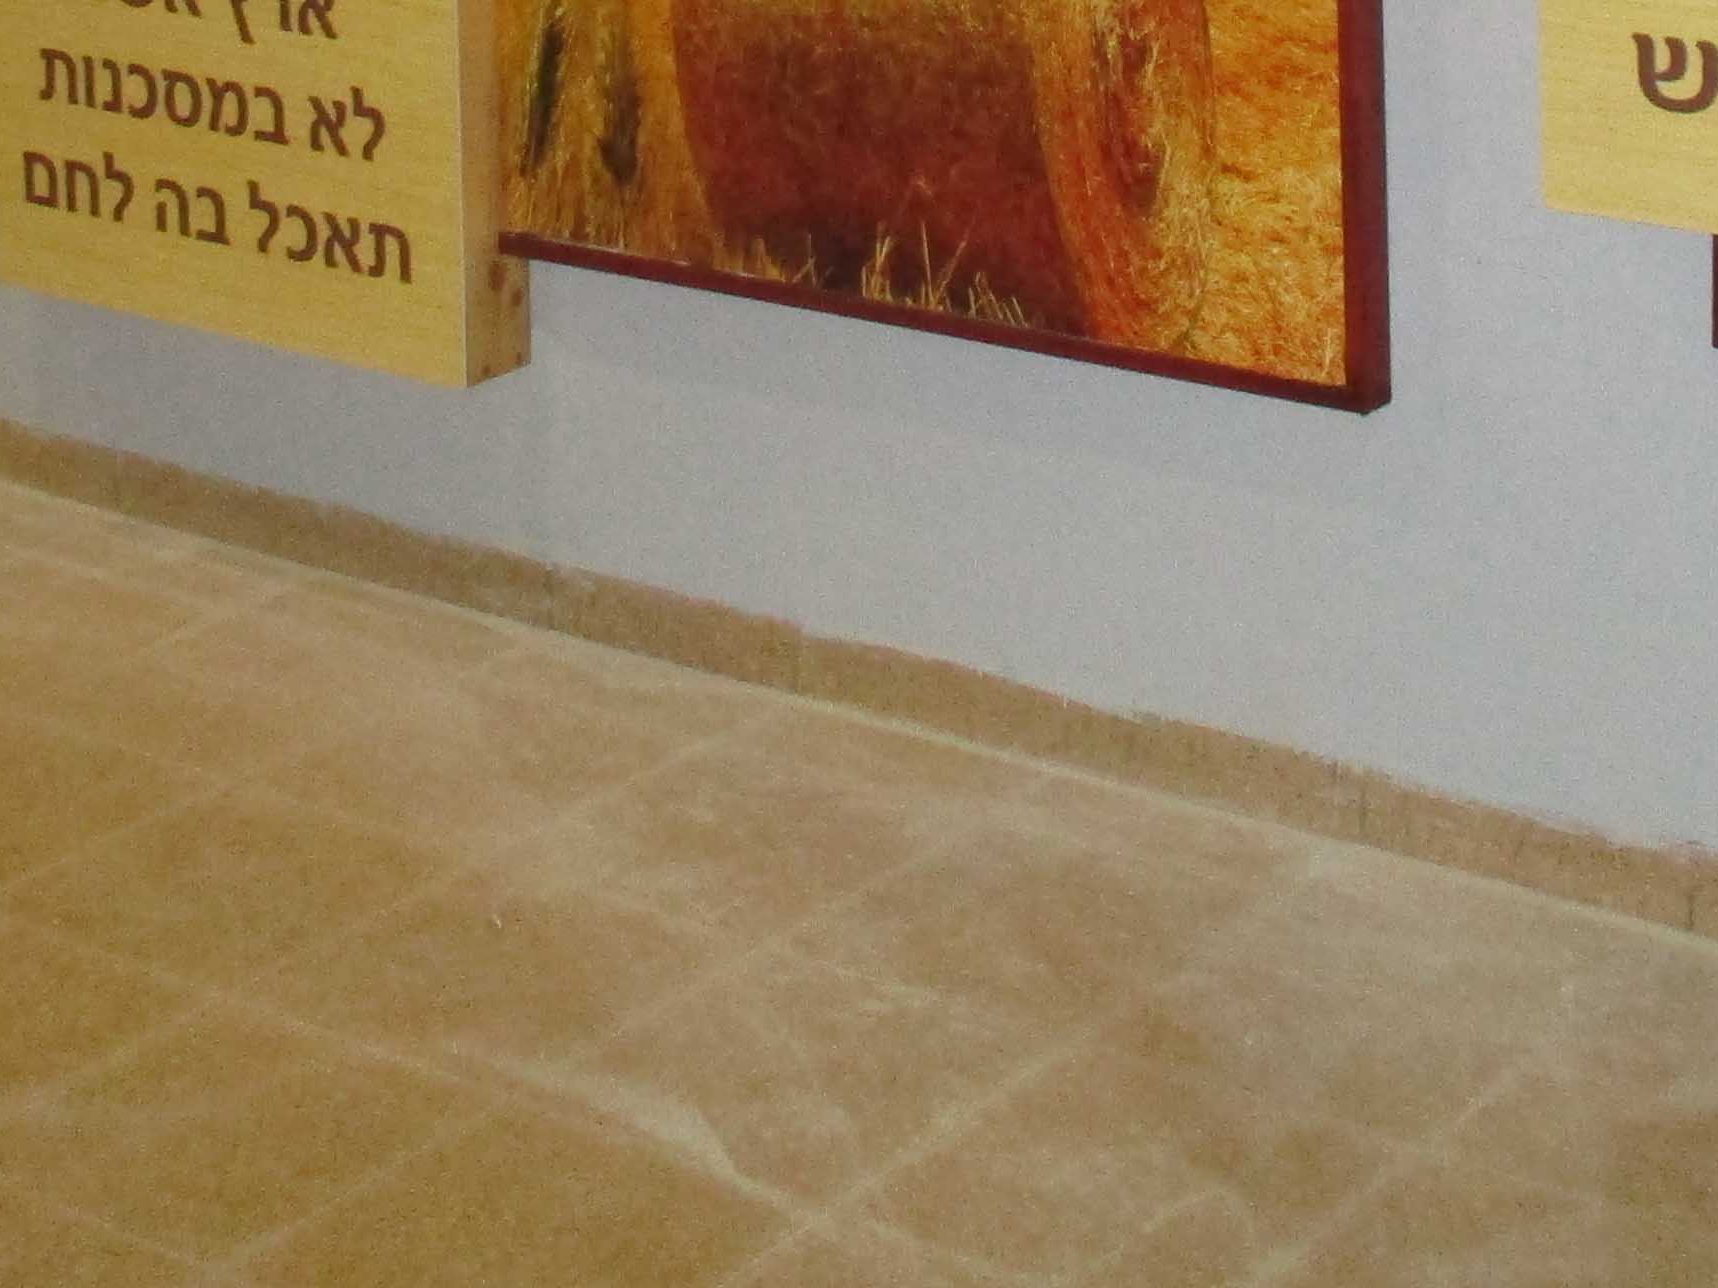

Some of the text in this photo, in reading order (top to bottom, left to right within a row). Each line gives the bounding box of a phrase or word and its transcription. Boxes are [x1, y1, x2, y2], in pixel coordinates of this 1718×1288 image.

[40, 47, 386, 163] לא במסכנות
[23, 151, 413, 285] תאכל בה לחם
